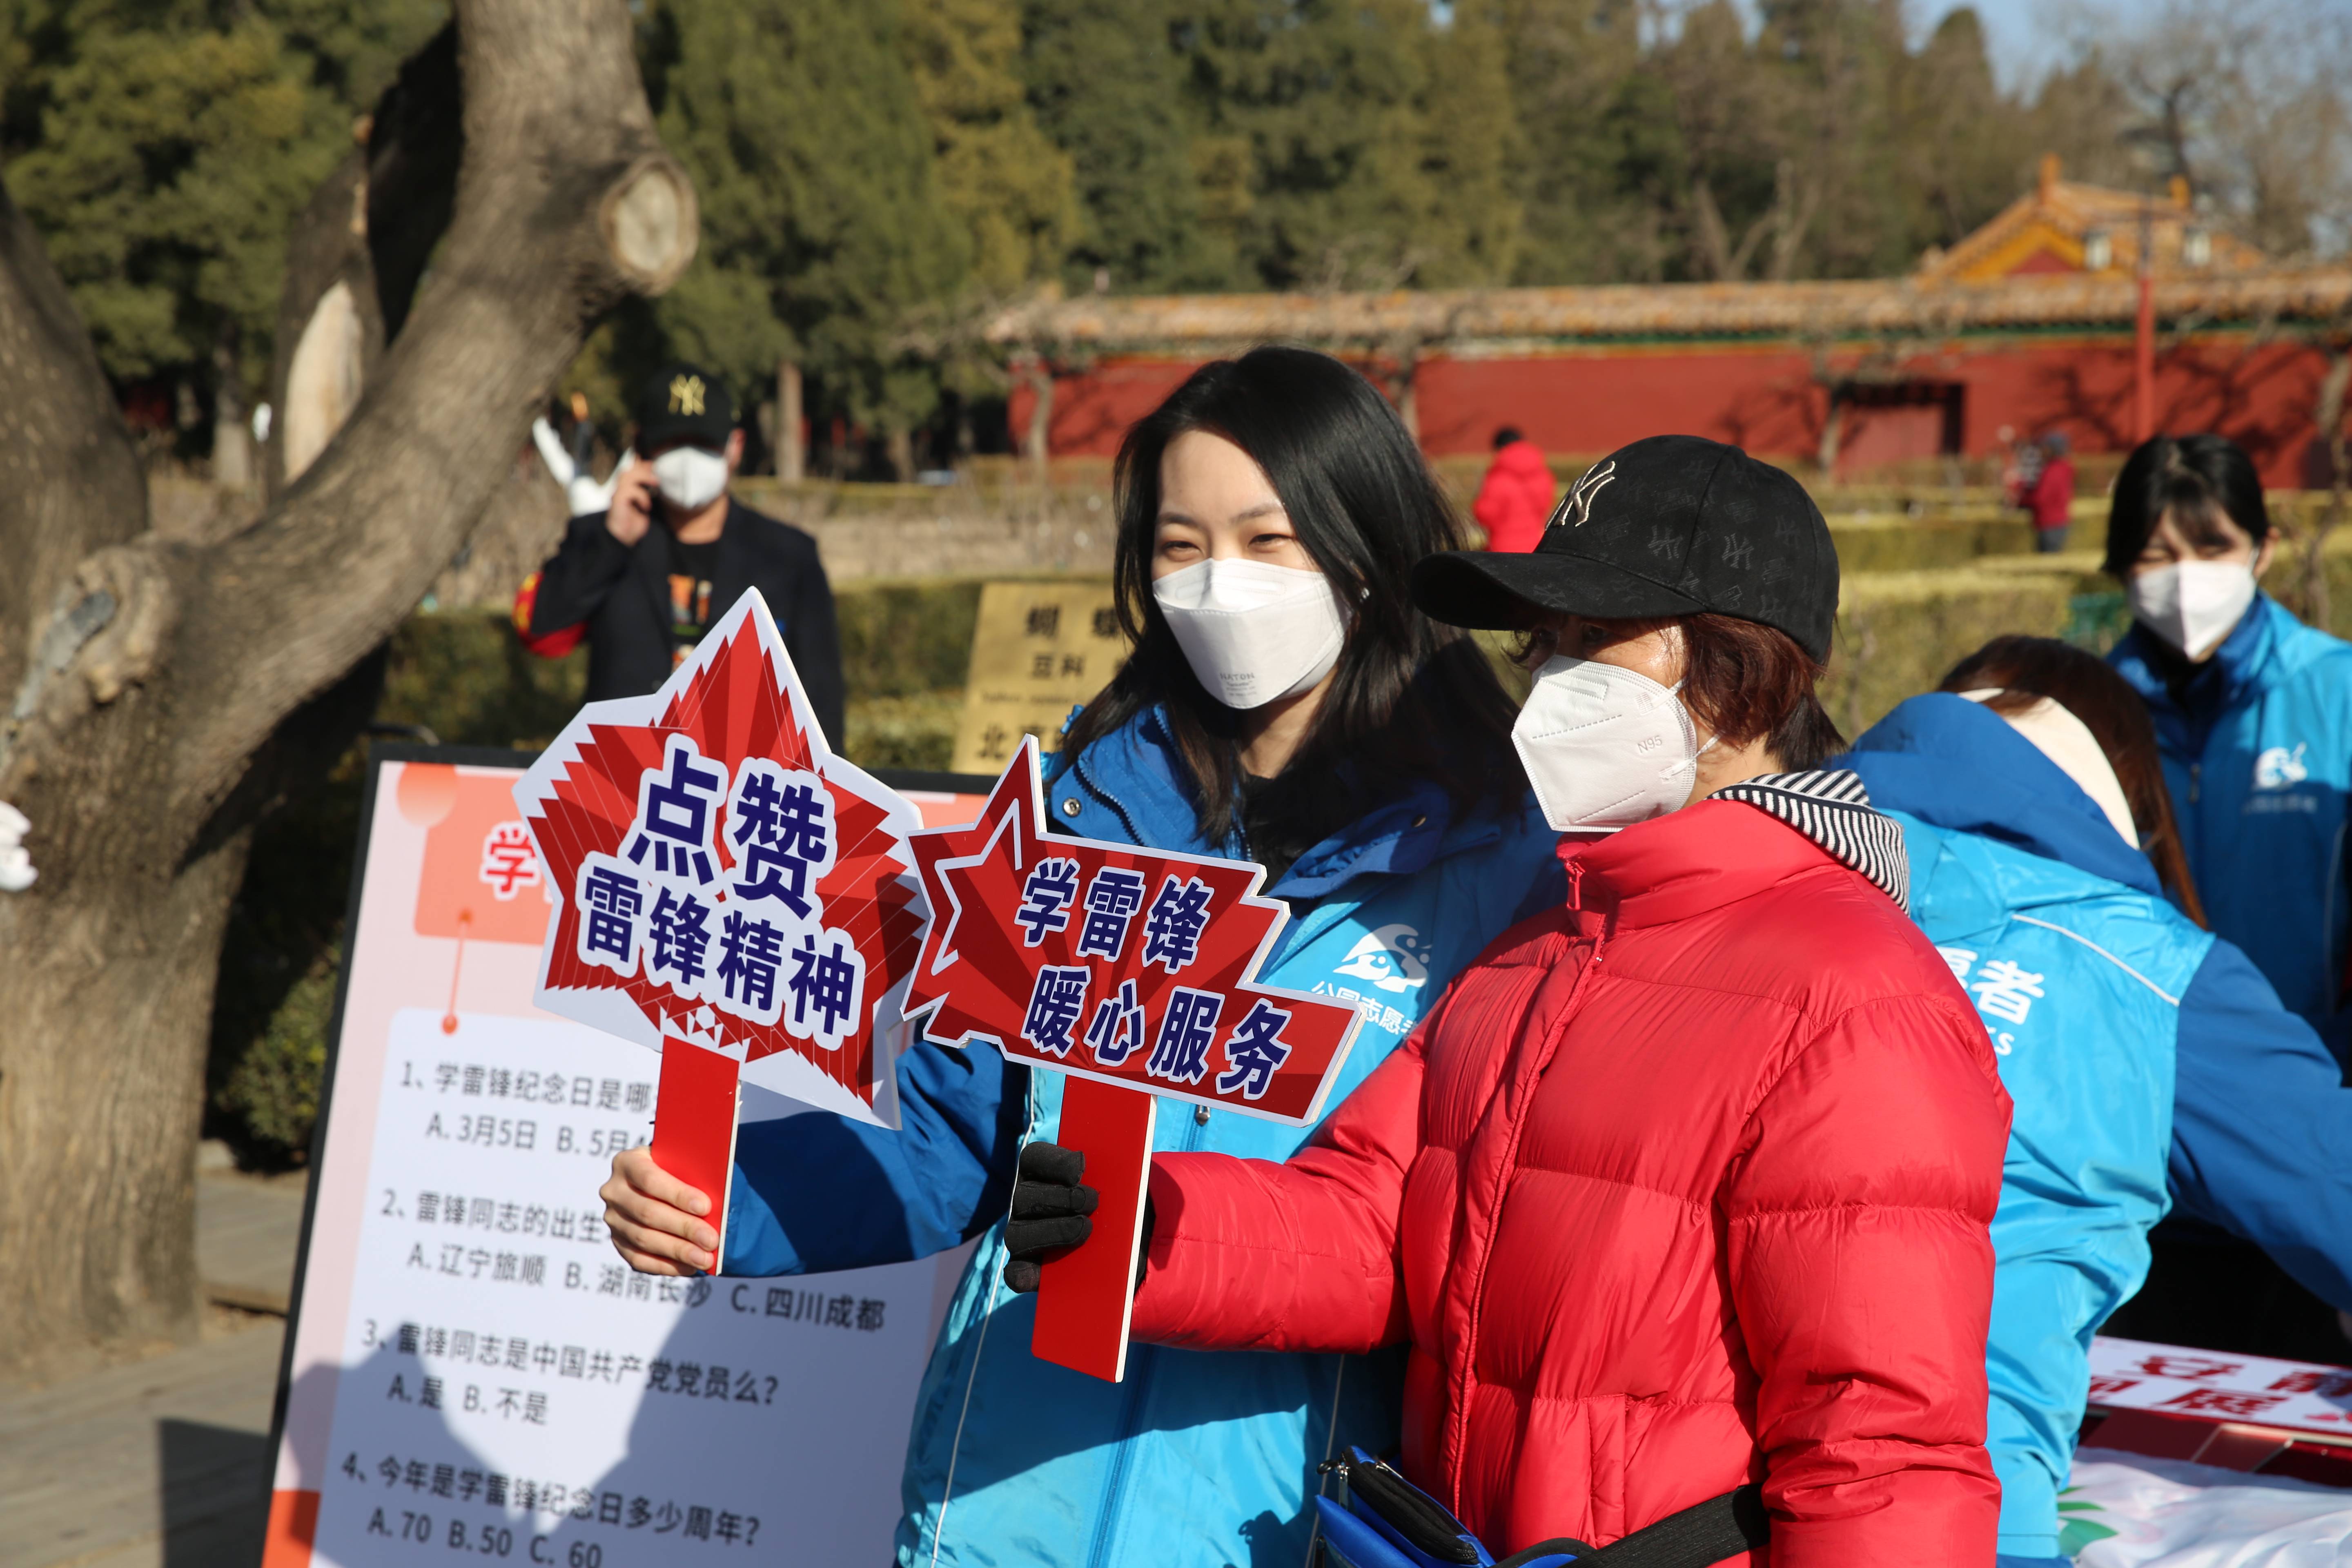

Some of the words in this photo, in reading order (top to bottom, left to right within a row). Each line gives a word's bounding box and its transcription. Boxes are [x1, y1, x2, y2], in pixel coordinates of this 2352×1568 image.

[1637, 735, 1662, 753] N95
[628, 748, 827, 920] 点赞
[585, 866, 855, 1036] 雷锋精神
[1018, 862, 1212, 970] 学雷锋
[1024, 969, 1289, 1096] 暖心服务
[381, 1188, 611, 1245] 2、雷锋同志的出生
